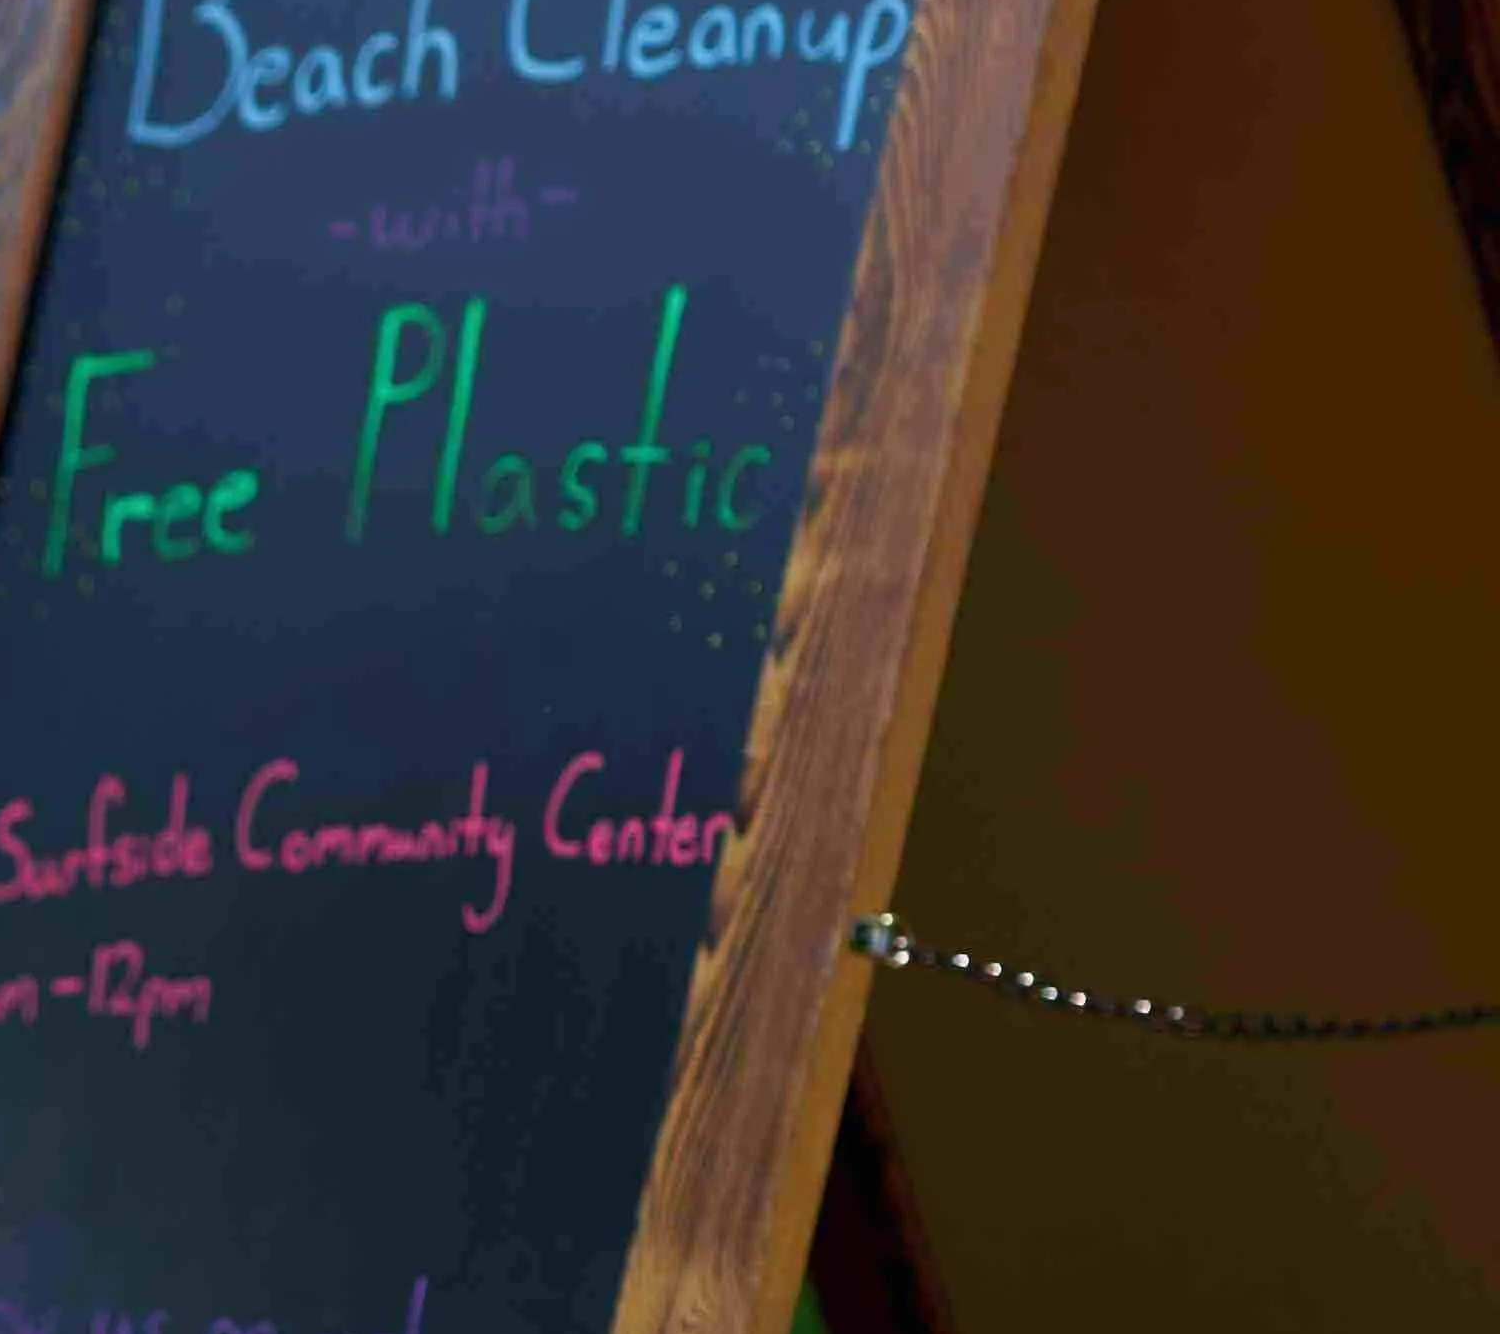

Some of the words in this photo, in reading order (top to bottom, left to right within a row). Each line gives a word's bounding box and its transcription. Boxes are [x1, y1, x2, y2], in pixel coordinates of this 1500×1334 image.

[43, 351, 261, 578] Free
[345, 285, 775, 543] Plastic
[234, 757, 516, 933] Community
[541, 747, 737, 867] Center
